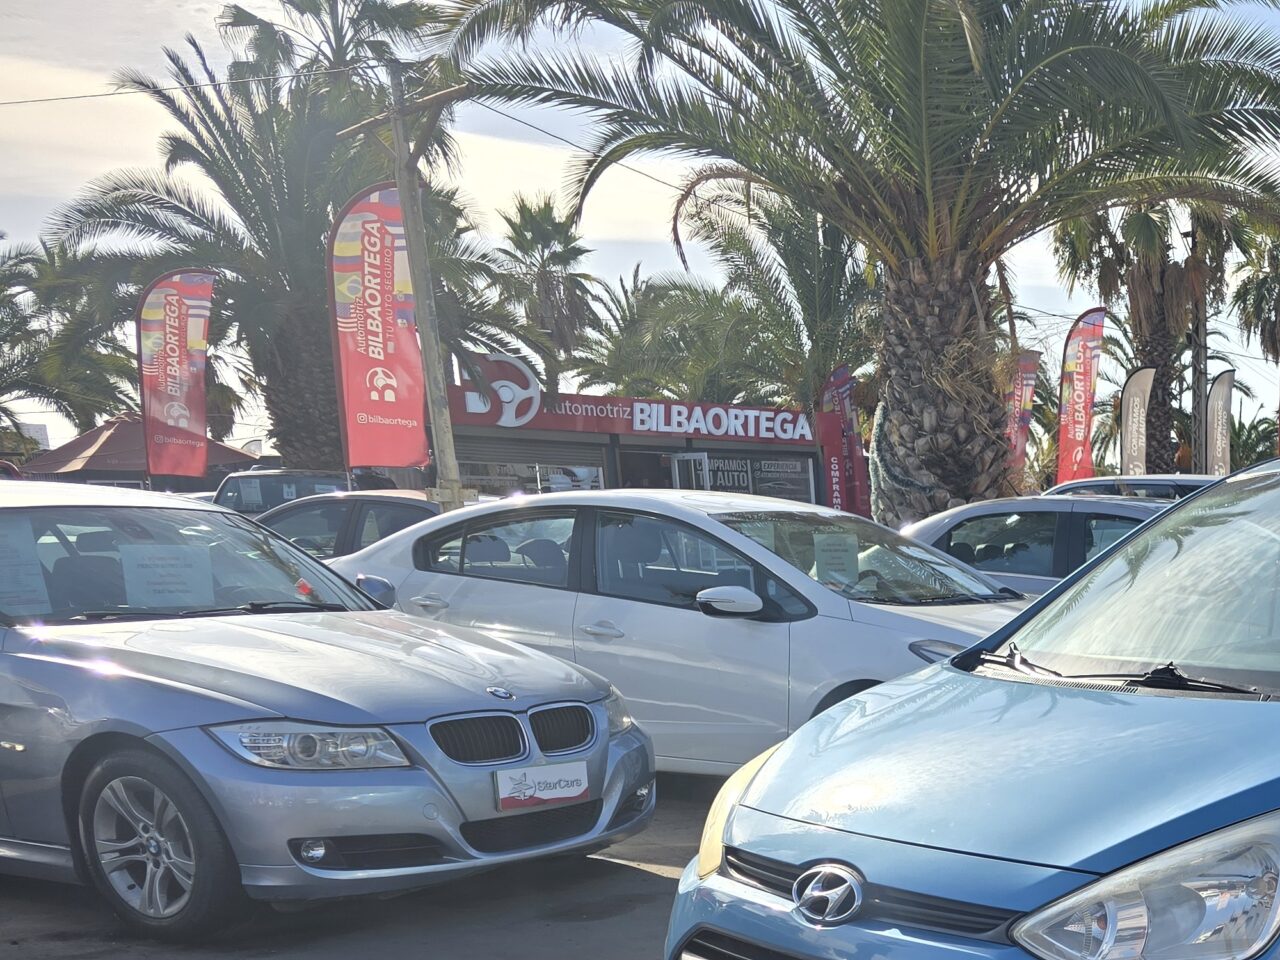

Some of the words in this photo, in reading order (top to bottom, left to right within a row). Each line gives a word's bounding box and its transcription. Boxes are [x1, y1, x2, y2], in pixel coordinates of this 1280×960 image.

[384, 248, 393, 291] SEGURO
[364, 221, 385, 360] BILBAORTEGA
[355, 297, 367, 354] Automotriz
[385, 293, 394, 324] AUTO
[166, 294, 181, 397] BILBAORTEGA
[386, 325, 395, 339] TU
[157, 349, 166, 392] Automotriz
[1073, 341, 1087, 441] BILBAORTEGA
[368, 415, 418, 428] bilbaortega
[632, 402, 813, 441] BILBAORTEGA
[1131, 397, 1140, 456] COMPRAMOS
[164, 436, 205, 448] bilbaortega
[1139, 433, 1145, 446] TU
[696, 459, 747, 471] CMPRAMOS
[717, 471, 748, 487] AUTO
[537, 778, 583, 791] StarCars
